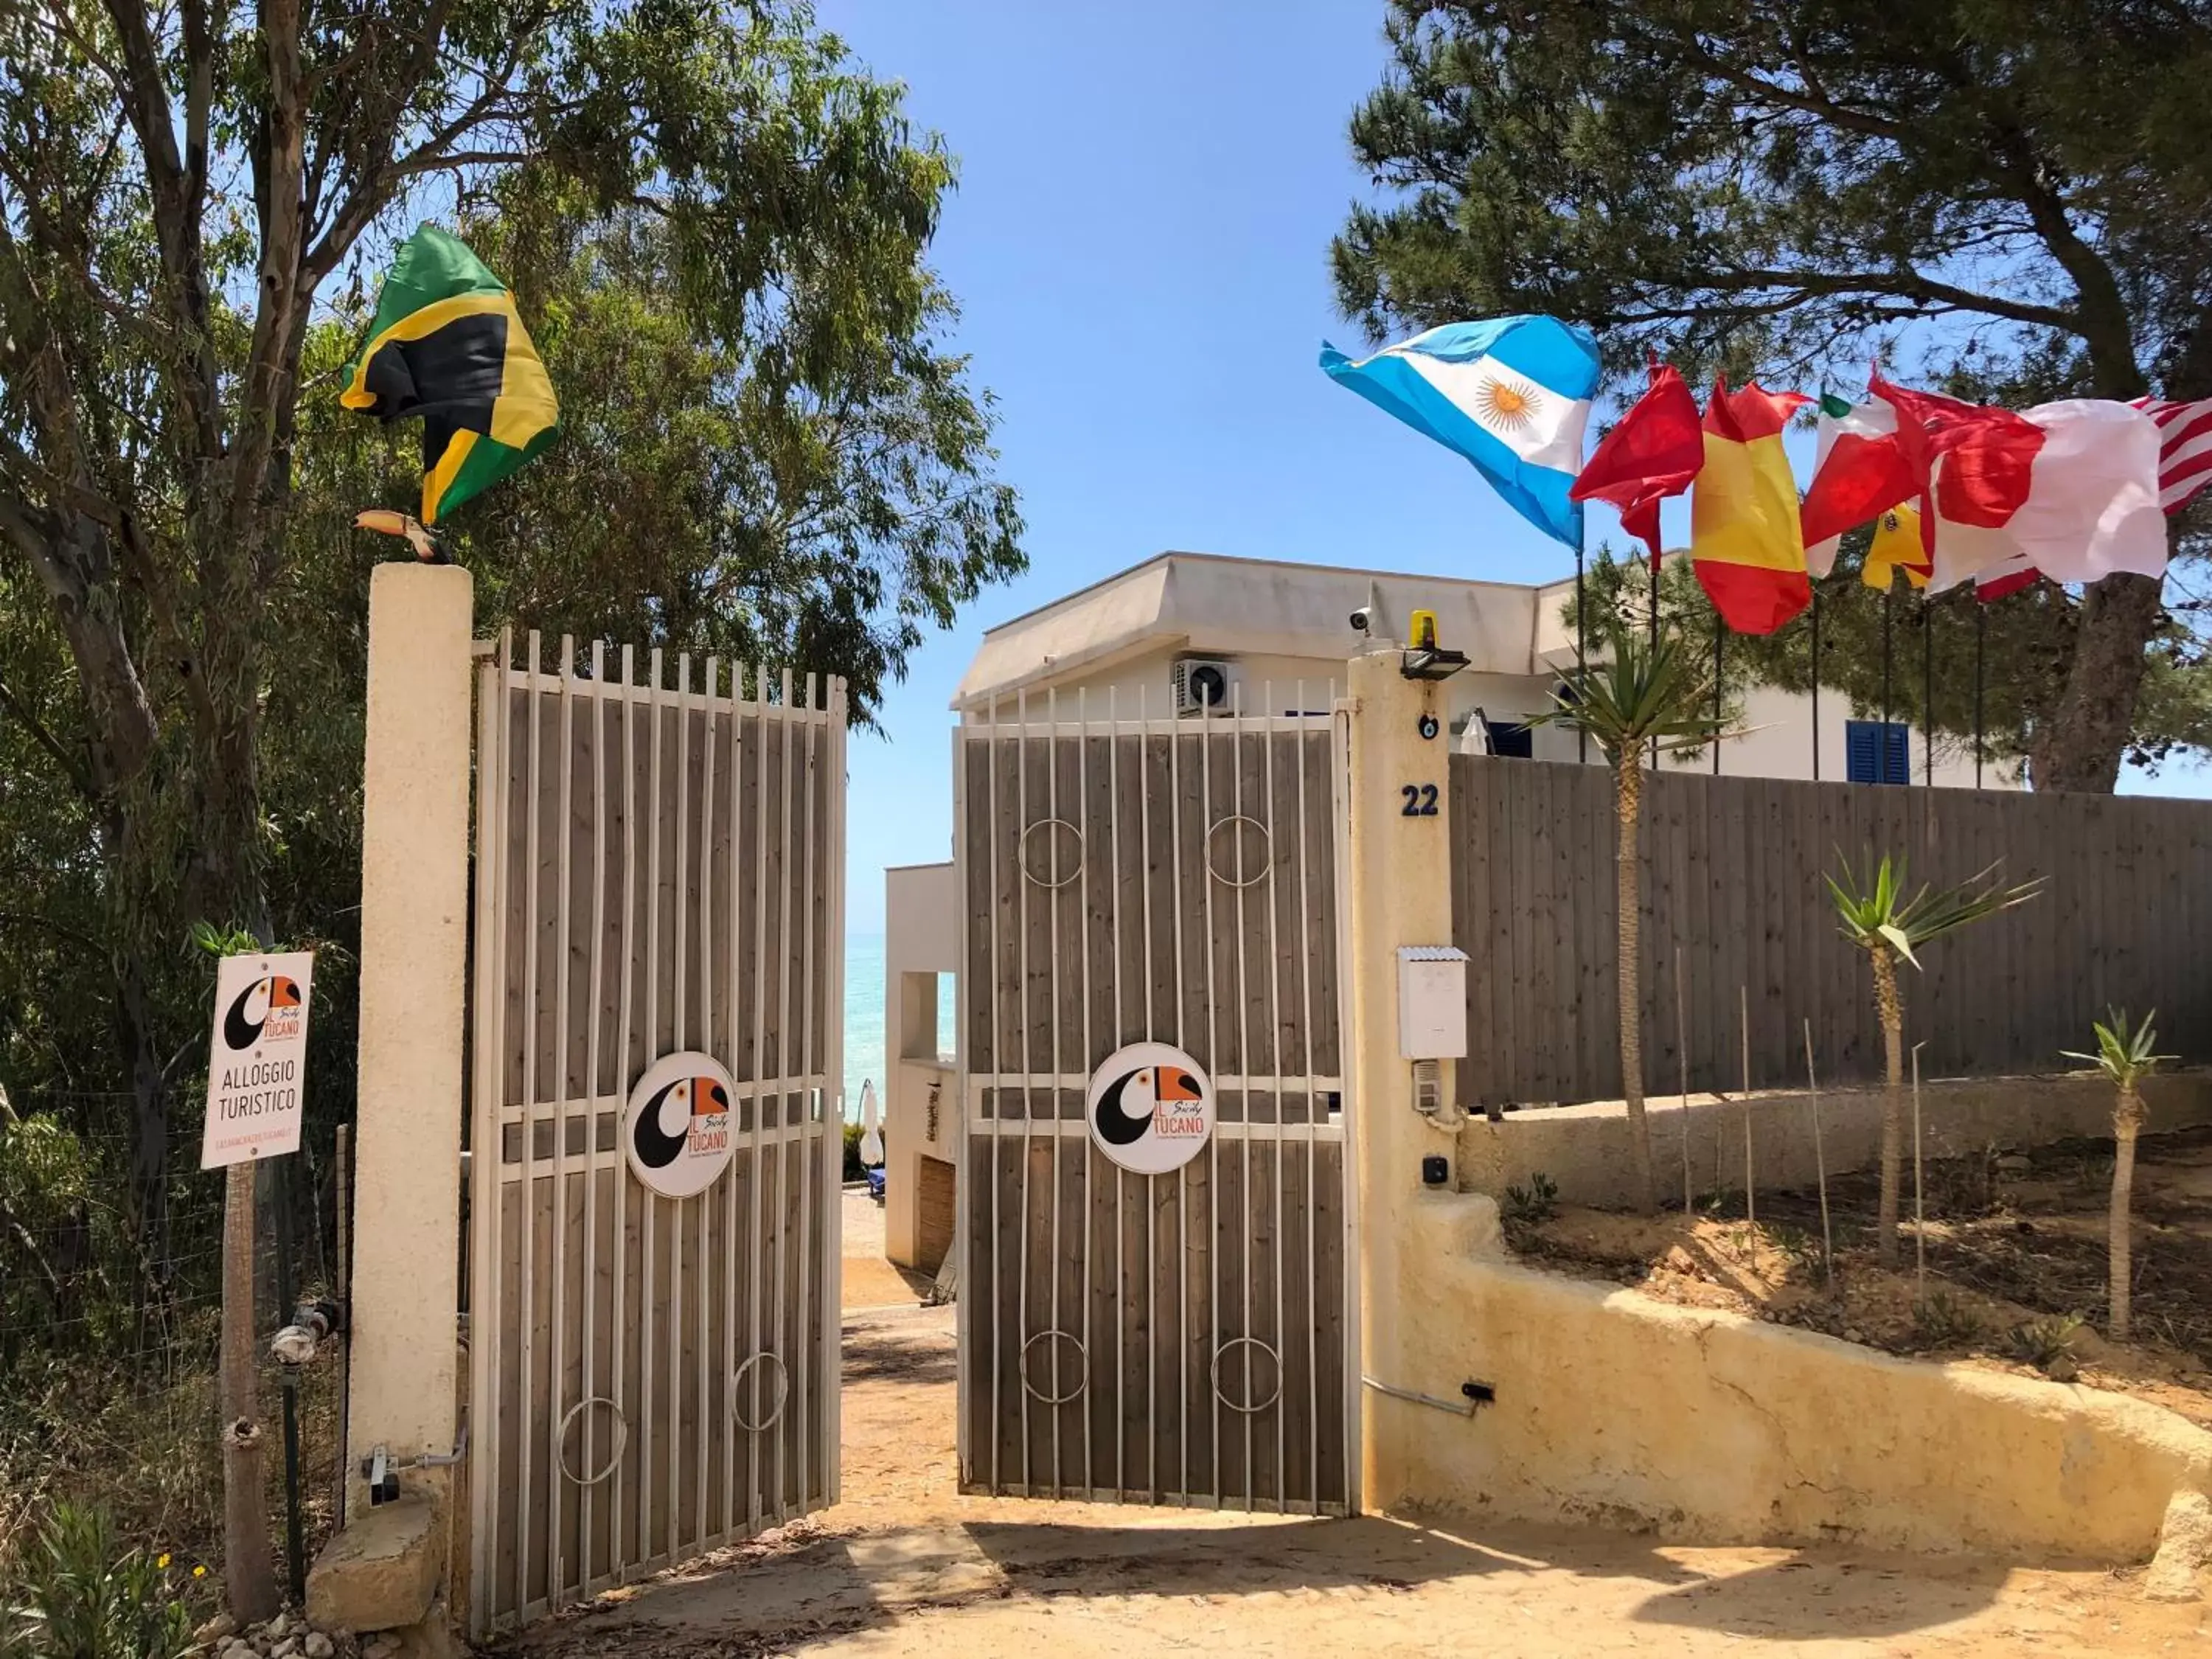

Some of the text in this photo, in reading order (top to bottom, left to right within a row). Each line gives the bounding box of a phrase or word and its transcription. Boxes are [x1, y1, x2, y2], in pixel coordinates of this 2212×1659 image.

[1402, 784, 1439, 816] 22
[264, 1020, 299, 1037] TUCANO
[222, 1060, 295, 1091] ALLOGGIO
[219, 1088, 296, 1121] TURISTICO
[1155, 1102, 1166, 1116] IL
[1173, 1100, 1203, 1116] Sicily
[1153, 1117, 1204, 1135] TUCANO
[687, 1131, 728, 1153] TUCANO
